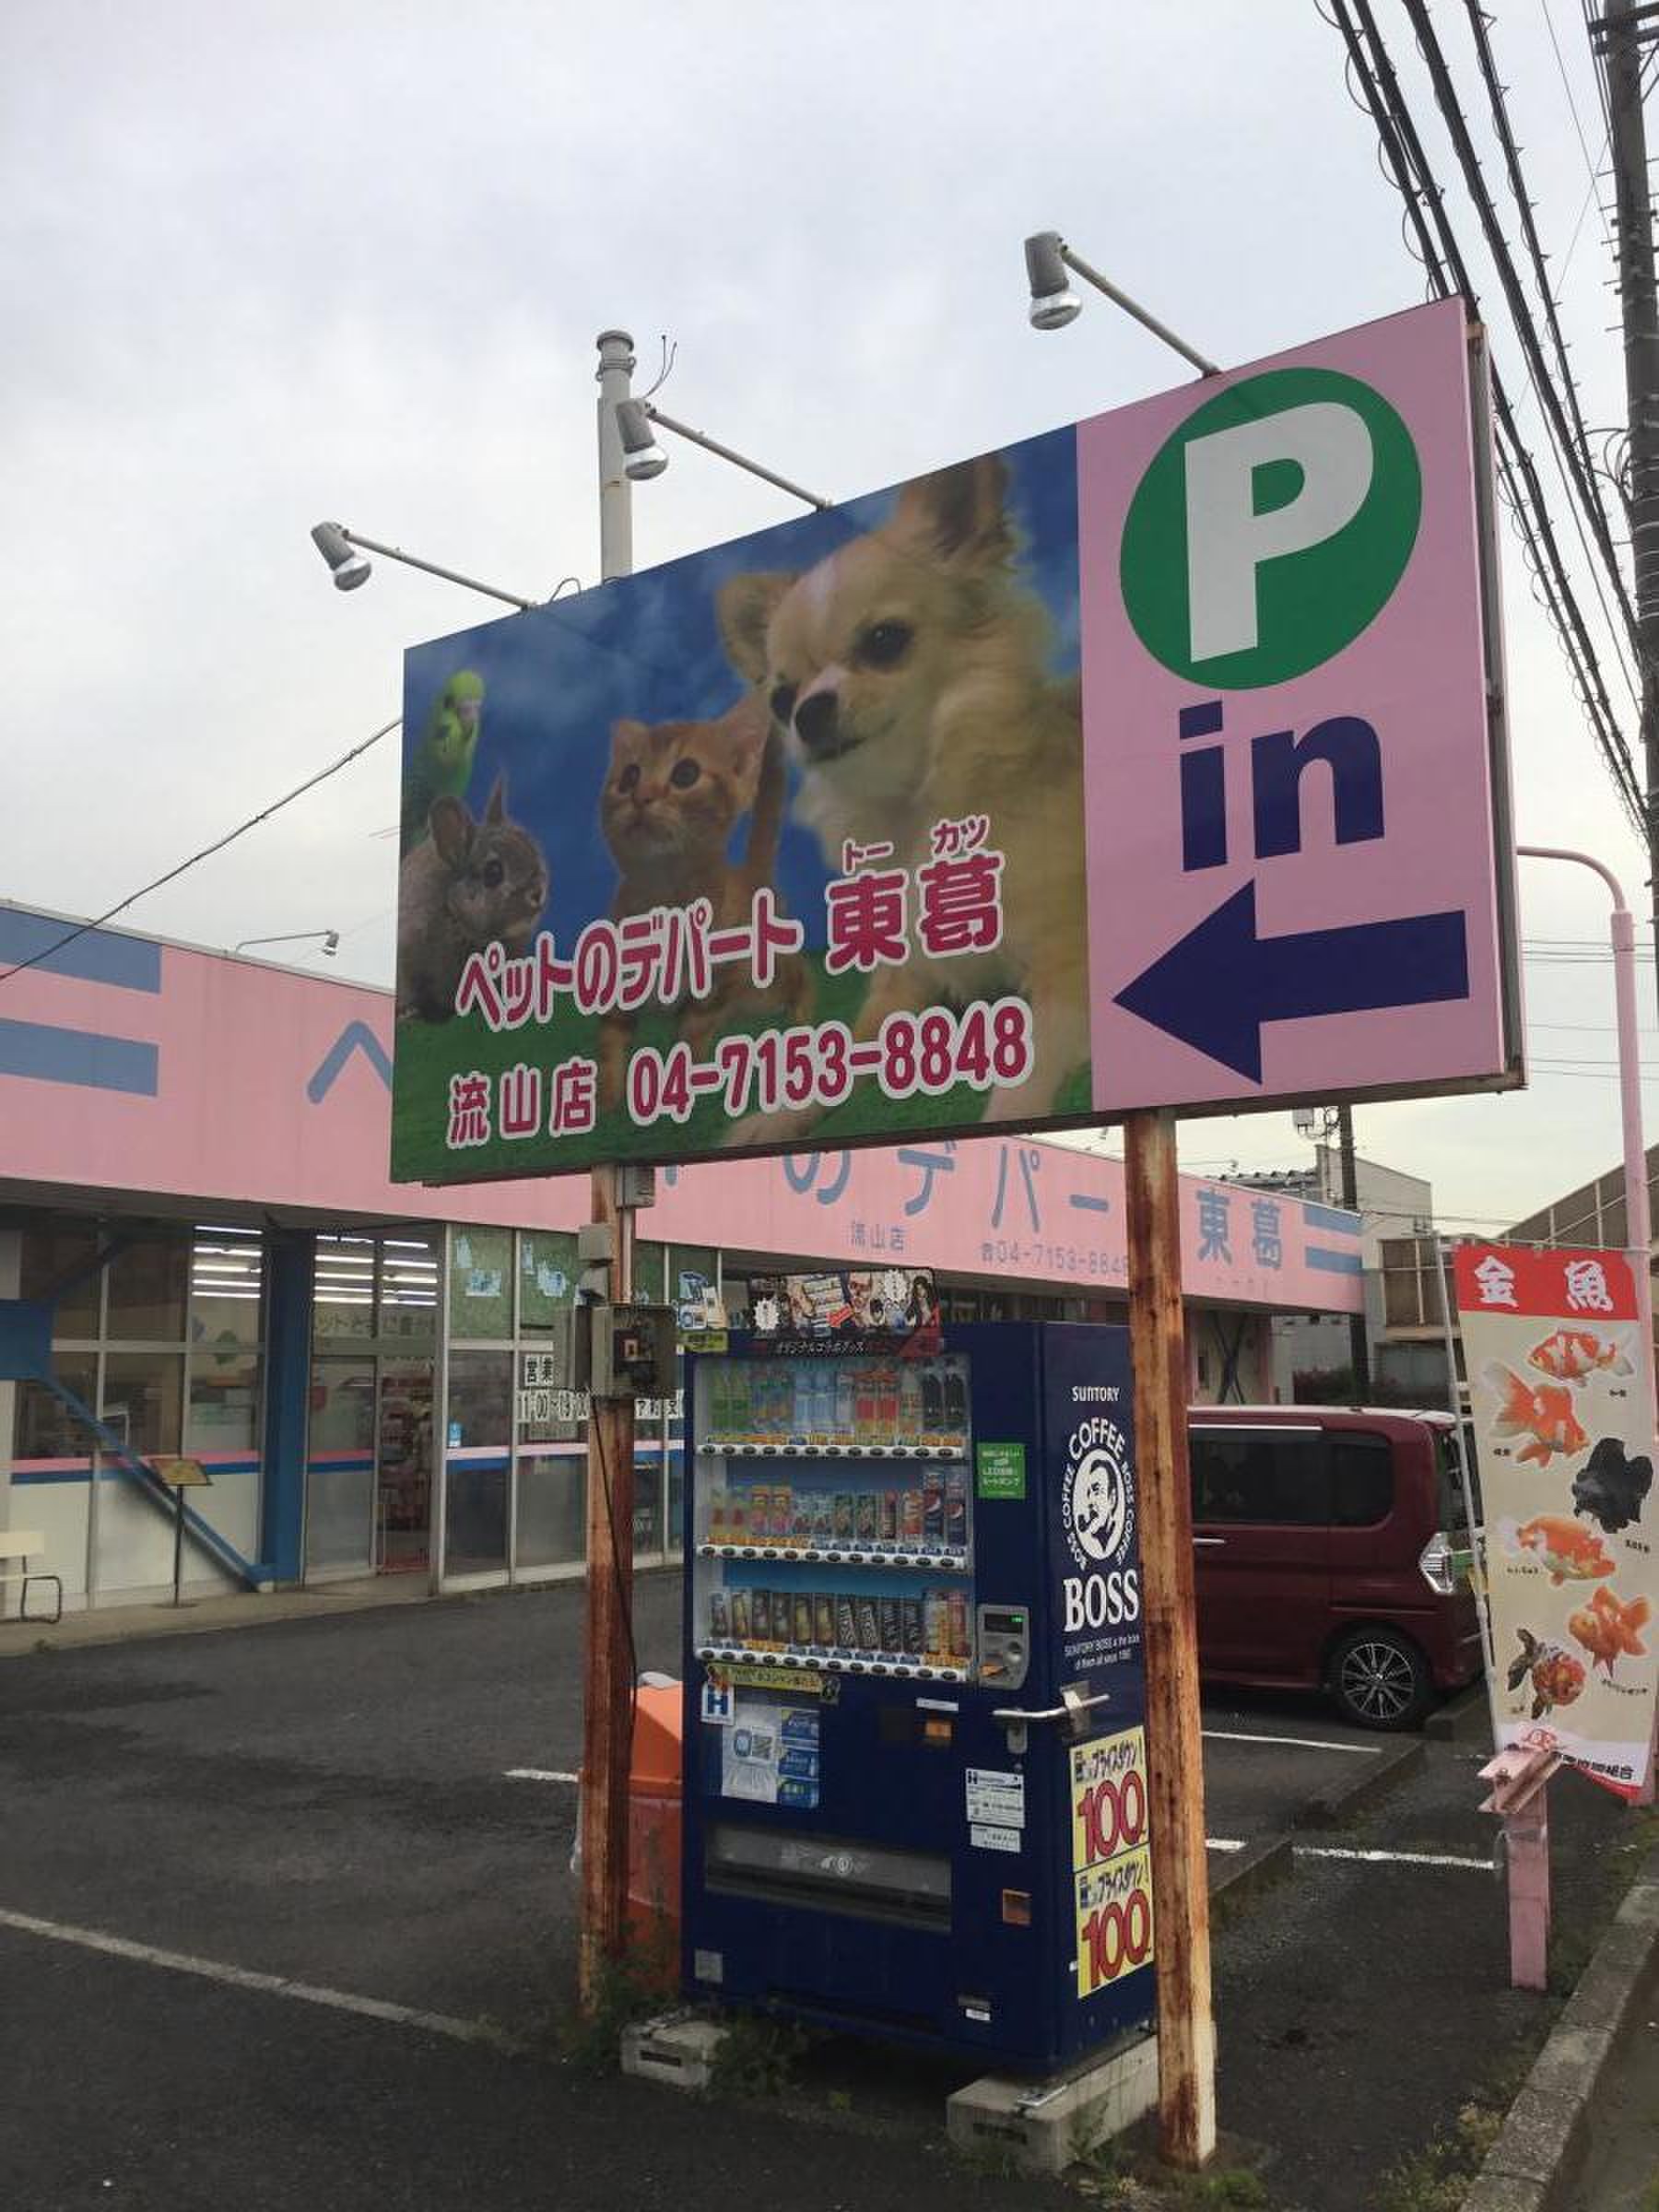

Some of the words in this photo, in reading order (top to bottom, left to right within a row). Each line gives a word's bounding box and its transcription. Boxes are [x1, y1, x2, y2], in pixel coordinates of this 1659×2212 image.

[1184, 401, 1374, 664] P
[931, 815, 990, 855] カツ
[1179, 699, 1385, 872] in
[458, 890, 802, 1030] ペットのデパート
[829, 853, 1006, 973] 東葛
[448, 1060, 596, 1148] 流山店
[628, 998, 1031, 1125] 04-7153-8848
[1068, 1417, 1125, 1460] COFFEE
[1063, 1569, 1141, 1633] BOSS
[1077, 1770, 1145, 1865] 100
[1081, 1888, 1150, 1990] 100
